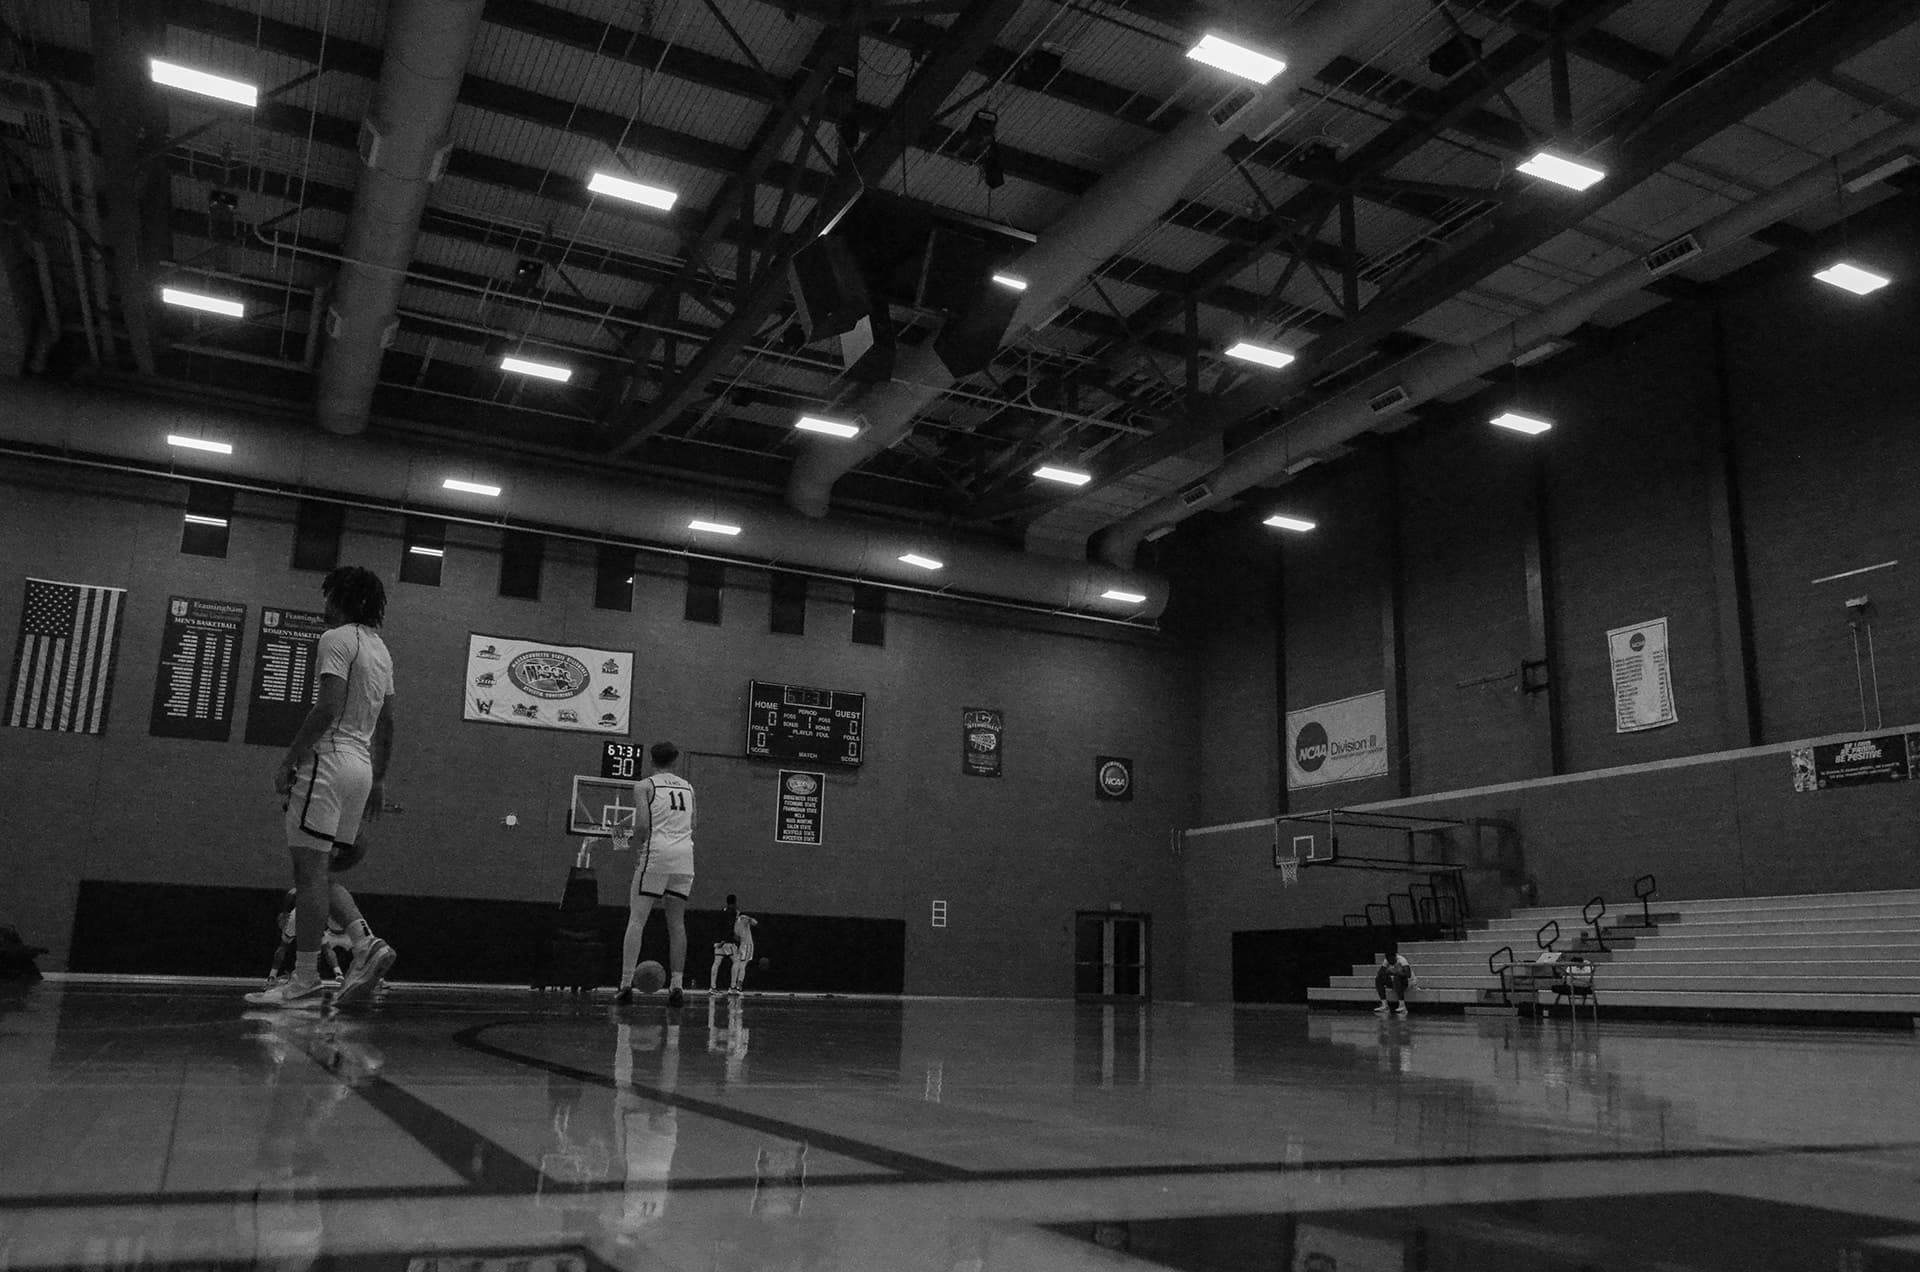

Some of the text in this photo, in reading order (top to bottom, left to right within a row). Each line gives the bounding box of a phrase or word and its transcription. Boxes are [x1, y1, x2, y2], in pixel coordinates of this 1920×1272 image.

[175, 617, 195, 625] MEN'S
[196, 619, 237, 629] BASKETBALL
[285, 612, 325, 624] Framingha
[754, 700, 778, 710] HOME
[768, 711, 777, 726] 0
[798, 708, 817, 717] PERIOD
[835, 709, 861, 719] GUEST
[751, 724, 769, 732] FOULS
[807, 716, 812, 729] 1
[849, 720, 858, 735] 0
[792, 729, 813, 737] PLAYER
[842, 734, 860, 742] FOULS
[757, 732, 766, 747] 0
[607, 744, 641, 758] 67:31
[750, 746, 770, 754] SCORE
[848, 742, 857, 757] 0
[1299, 743, 1328, 762] NCAA
[1331, 738, 1367, 756] Division
[798, 751, 818, 759] MATCH
[1835, 749, 1882, 763] BE POSITIVE
[611, 756, 634, 777] 30
[1105, 777, 1125, 786] NCAA
[669, 790, 686, 811] 11
